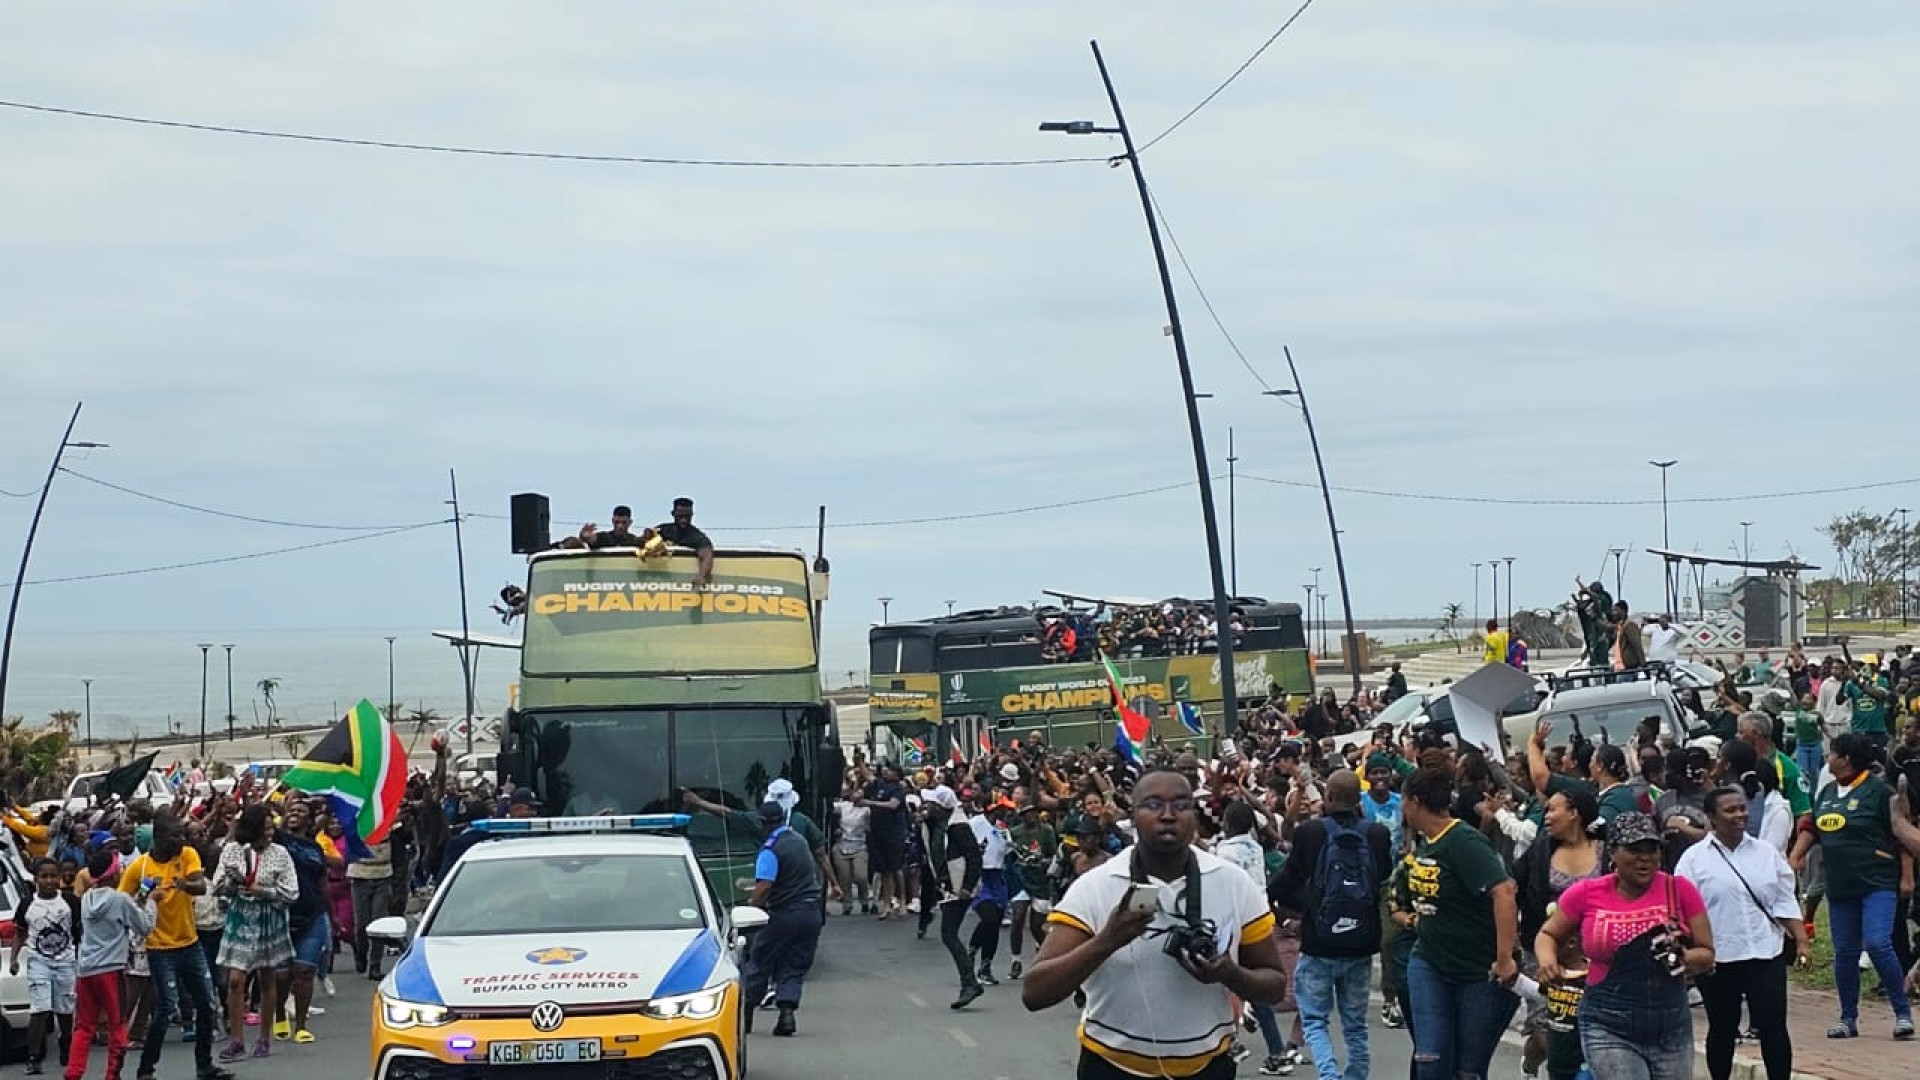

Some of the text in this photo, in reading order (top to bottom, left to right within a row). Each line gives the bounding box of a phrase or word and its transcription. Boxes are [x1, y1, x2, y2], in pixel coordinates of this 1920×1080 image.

[563, 582, 625, 592] RUGBY
[629, 582, 693, 592] WORLD
[738, 584, 784, 595] 2023
[534, 592, 808, 619] CHAMPIONS
[1001, 683, 1165, 713] CHAMPINS
[462, 971, 638, 985] TRAFFIC SERVICES
[472, 981, 629, 994] BUFFALO CITY METRO
[493, 1041, 597, 1062] KGB 050 EC
